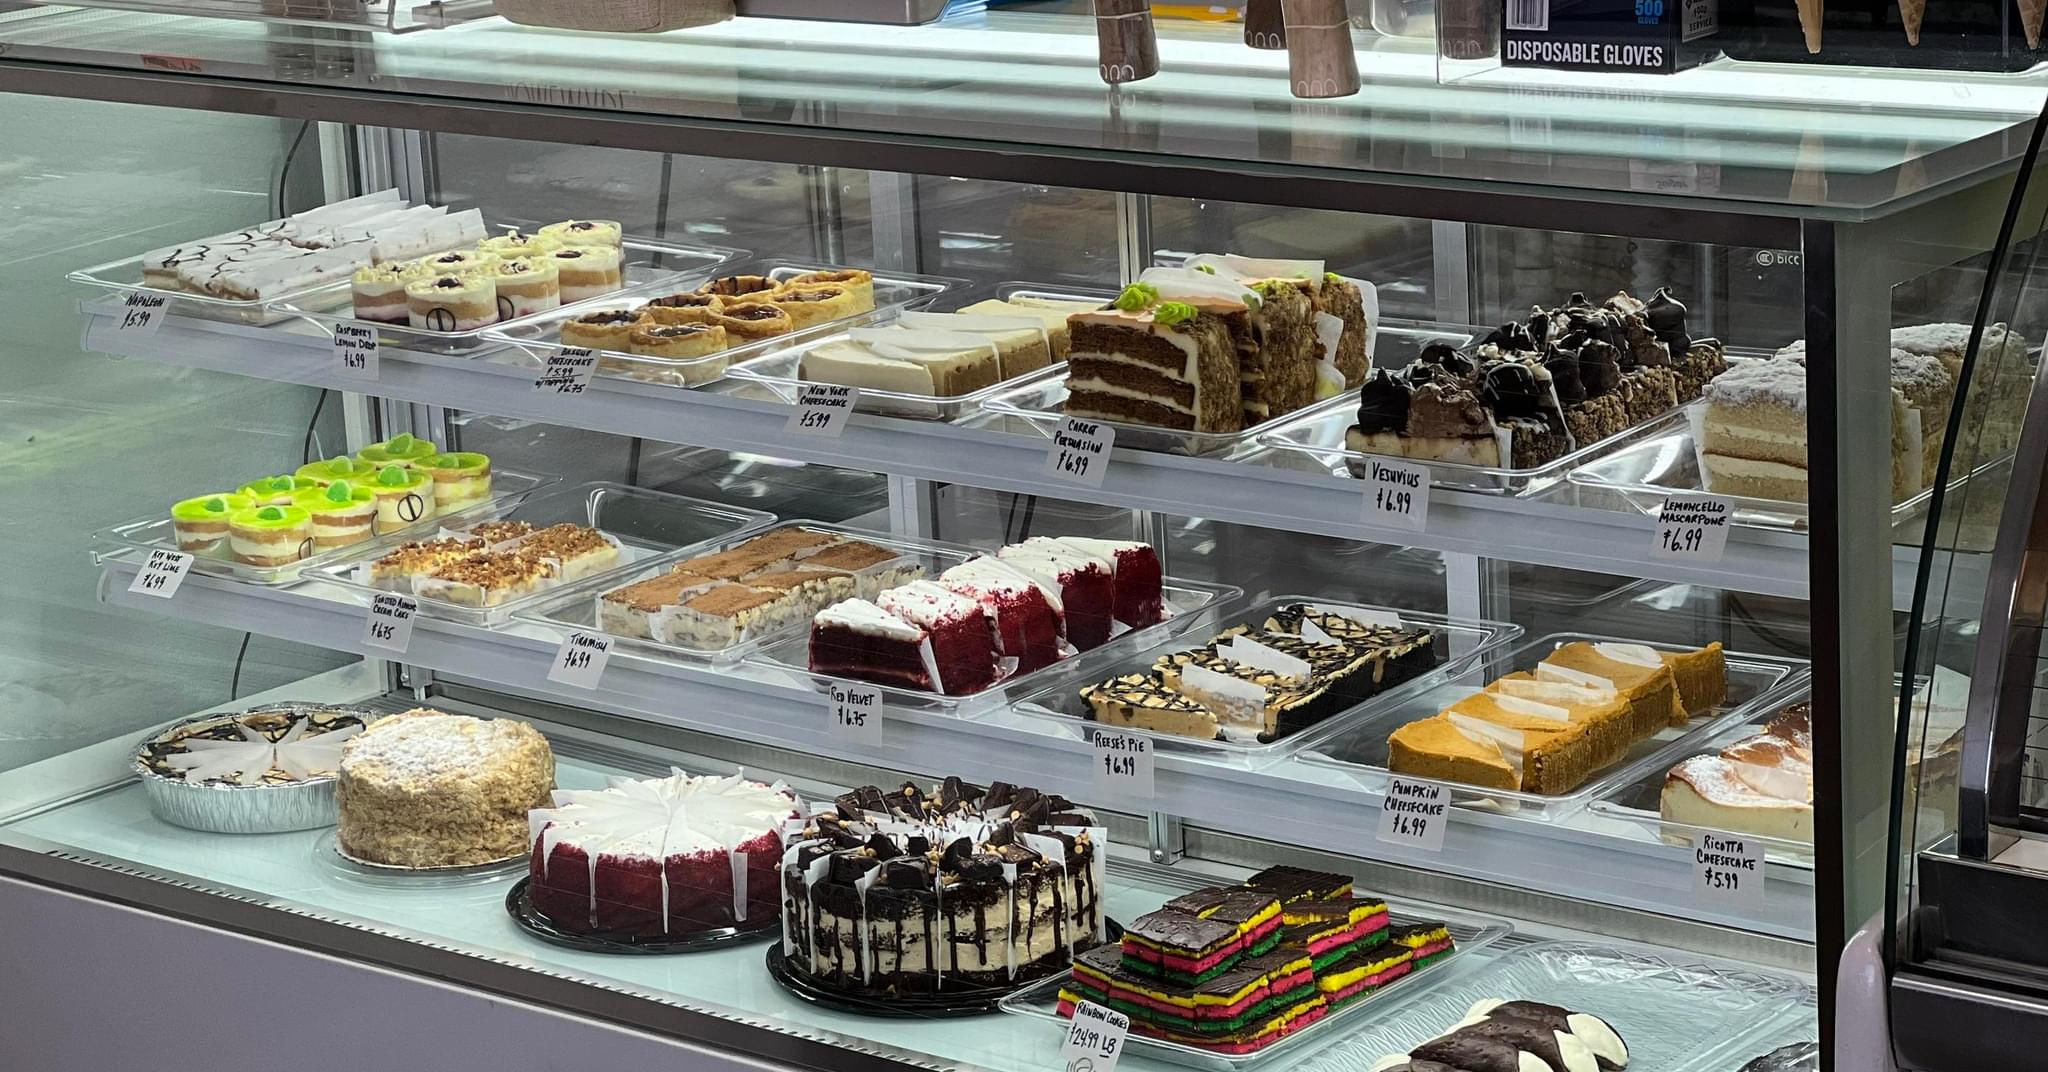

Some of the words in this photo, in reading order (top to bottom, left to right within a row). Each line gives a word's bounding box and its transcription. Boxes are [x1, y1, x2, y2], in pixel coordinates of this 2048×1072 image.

[1635, 0, 1664, 16] 500
[1506, 40, 1600, 64] DISPOSABLE
[1603, 44, 1663, 67] GLOVES
[125, 291, 165, 307] NAPOLEON
[120, 309, 151, 330] $5.99
[344, 350, 365, 369] $6.99
[808, 385, 828, 396] NEW
[829, 386, 851, 397] YORK
[1068, 419, 1099, 436] CARROT
[1054, 430, 1103, 454] PERSUASION
[1057, 449, 1089, 476] $6.99
[1372, 461, 1421, 488] VESUVIUS
[1376, 487, 1411, 514] $6.99
[1663, 498, 1725, 513] LEMONCELLO
[1659, 512, 1727, 526] MASCARPONE
[1663, 527, 1703, 552] $6.99
[148, 560, 164, 570] KEY
[151, 550, 165, 560] KEY
[564, 647, 591, 669] $6.99
[831, 686, 845, 703] RED
[847, 688, 875, 706] VELVET
[837, 705, 867, 727] $6.75
[1095, 731, 1125, 750] REESE'S
[1128, 737, 1145, 753] PIE
[1104, 753, 1135, 776] $6.99
[1392, 780, 1439, 799] PUMPKIN
[1384, 796, 1445, 816] CHEESECAKE
[1393, 813, 1427, 838] $6.99
[1703, 834, 1744, 854] RICOTTA
[1696, 847, 1756, 871] CHEESECAKE
[1704, 866, 1738, 890] $5.99
[1076, 1001, 1107, 1022] RAINBOW
[1068, 1022, 1099, 1049] $24.99
[1101, 1035, 1117, 1054] LB
